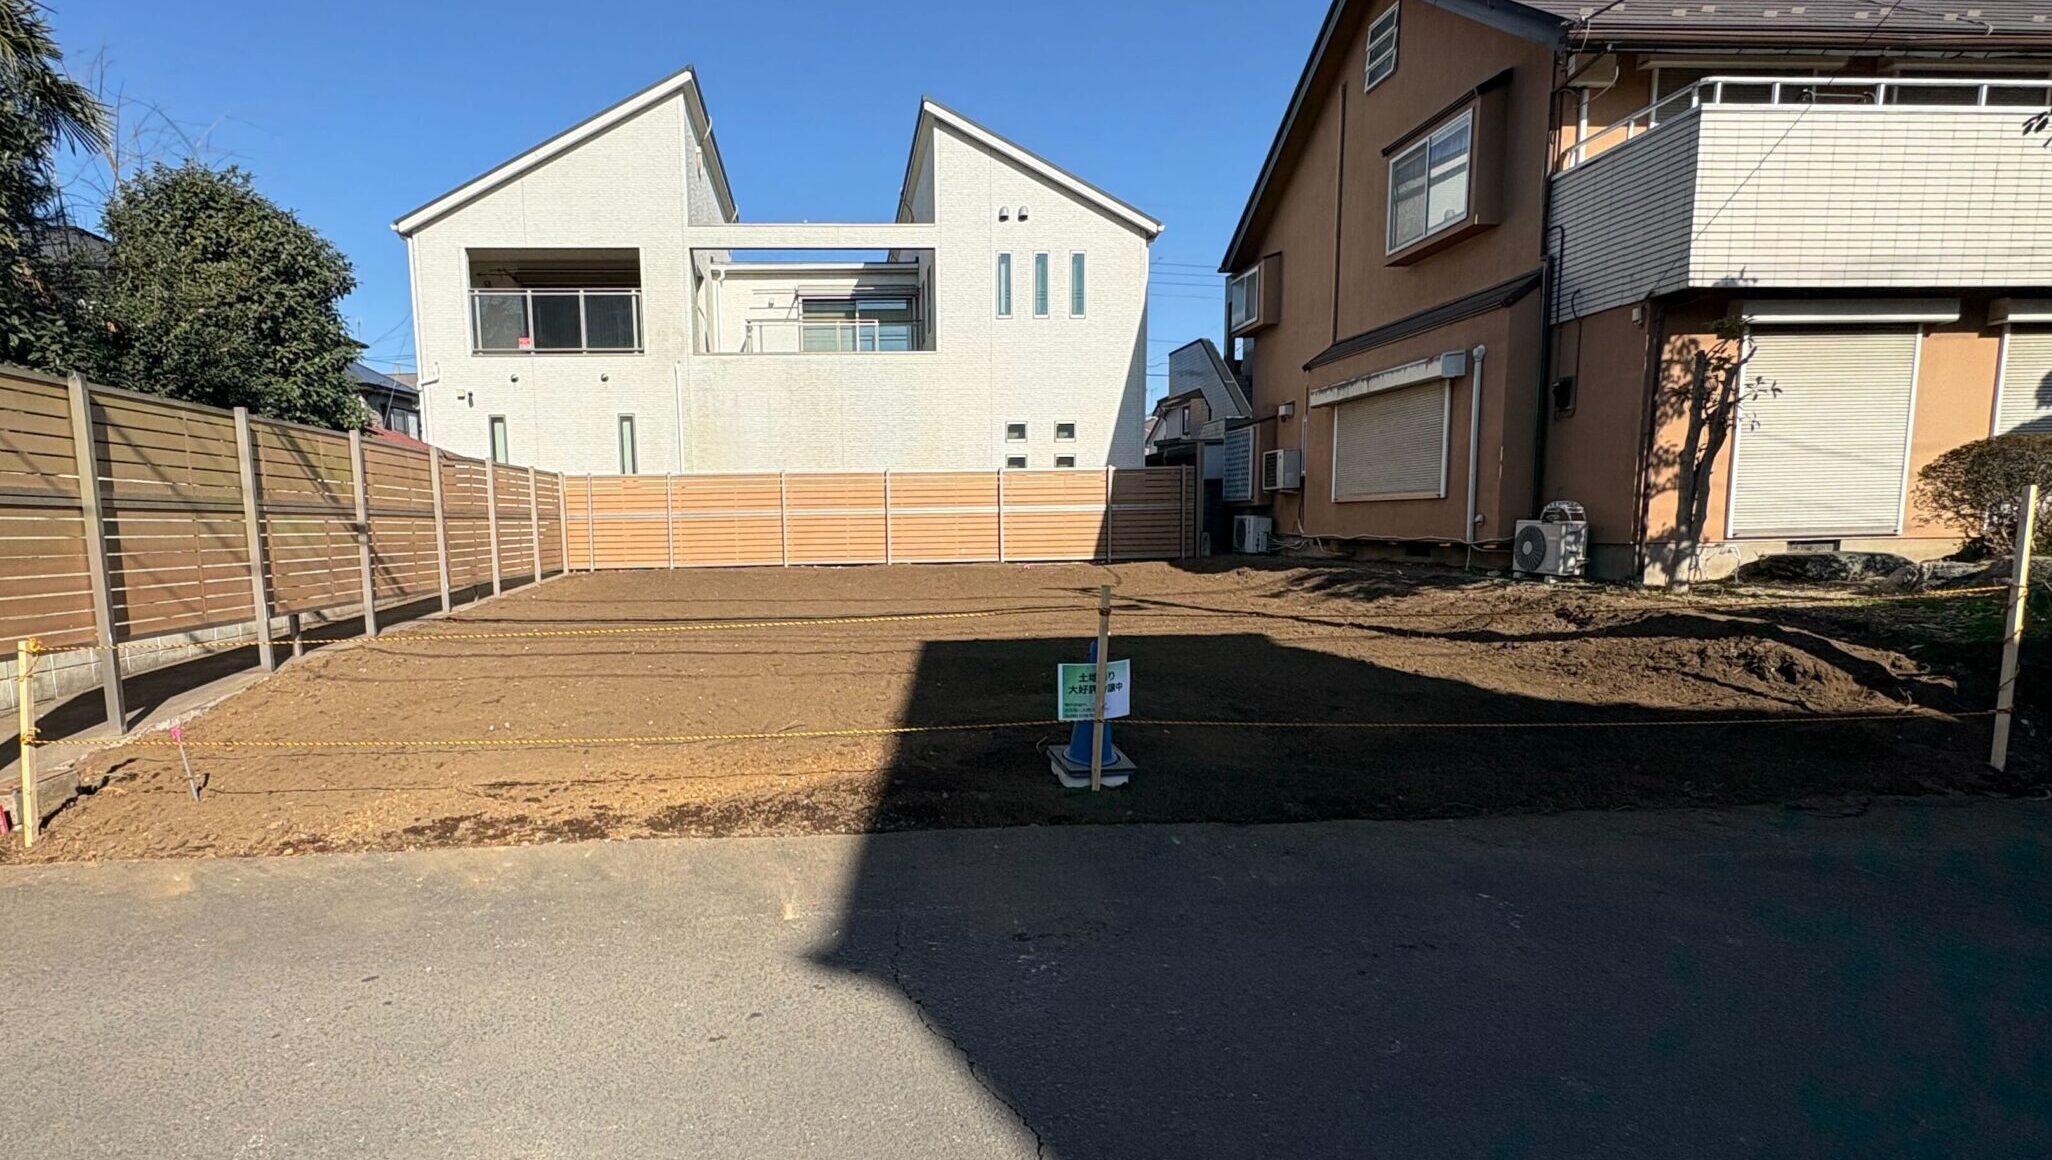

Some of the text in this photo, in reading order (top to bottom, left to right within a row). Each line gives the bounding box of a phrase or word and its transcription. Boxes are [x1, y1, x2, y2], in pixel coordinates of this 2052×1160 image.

[1079, 671, 1115, 683] 土地り
[1068, 682, 1123, 694] 大好評譲中
